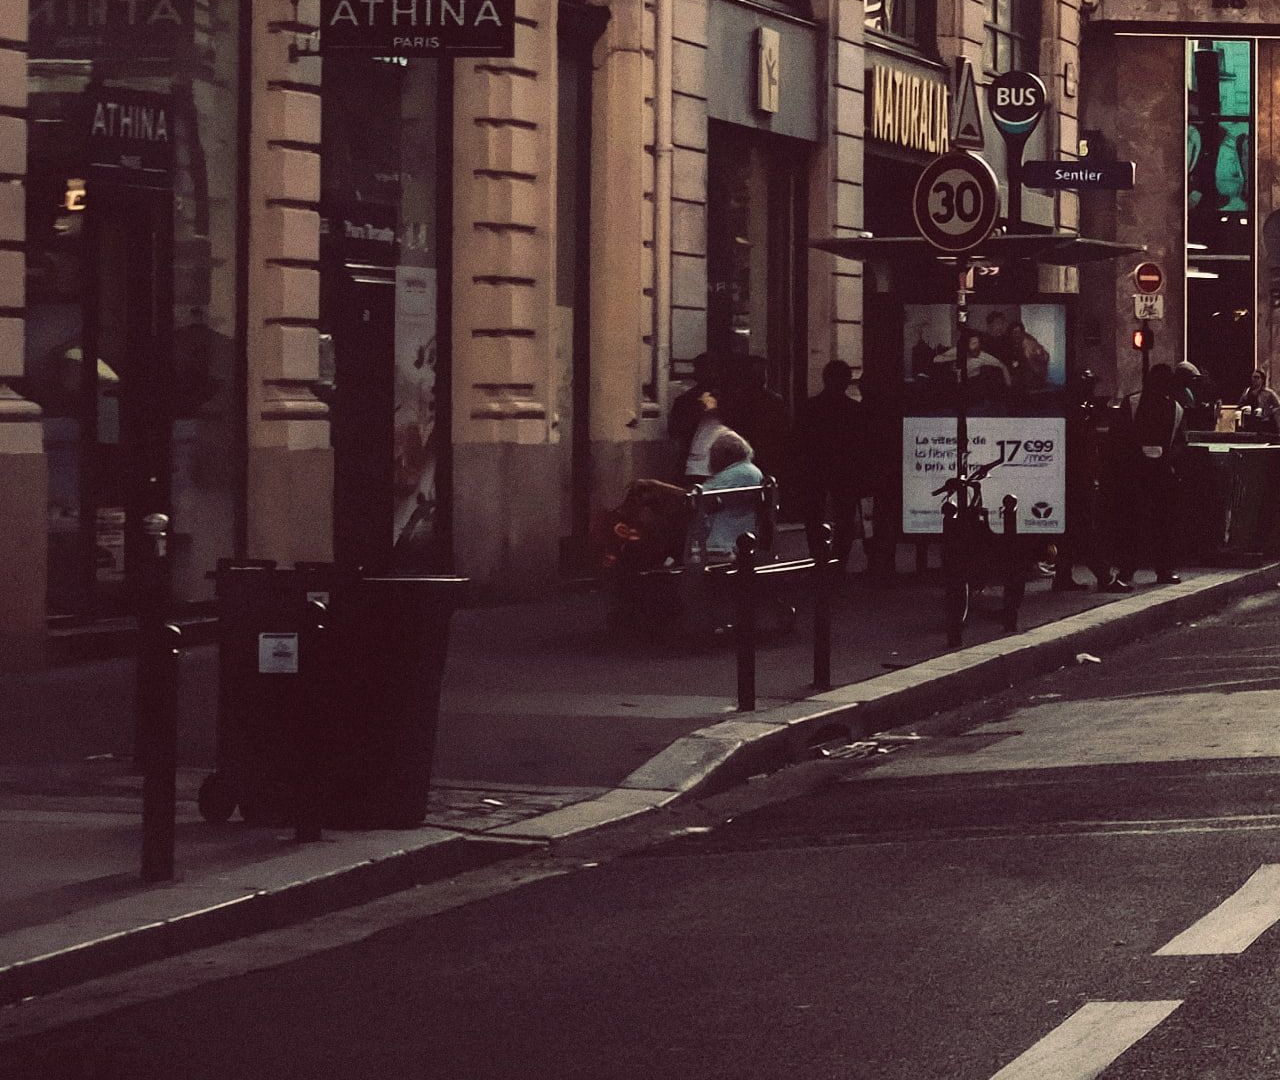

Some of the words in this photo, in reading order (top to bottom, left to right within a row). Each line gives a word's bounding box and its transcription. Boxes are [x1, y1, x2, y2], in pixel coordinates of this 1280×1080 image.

[393, 36, 441, 49] PARIS
[872, 63, 951, 156] NATURALIA
[996, 87, 1036, 107] BUS
[92, 102, 169, 143] ATHINA
[1055, 168, 1103, 182] Sentier
[931, 180, 983, 224] 30
